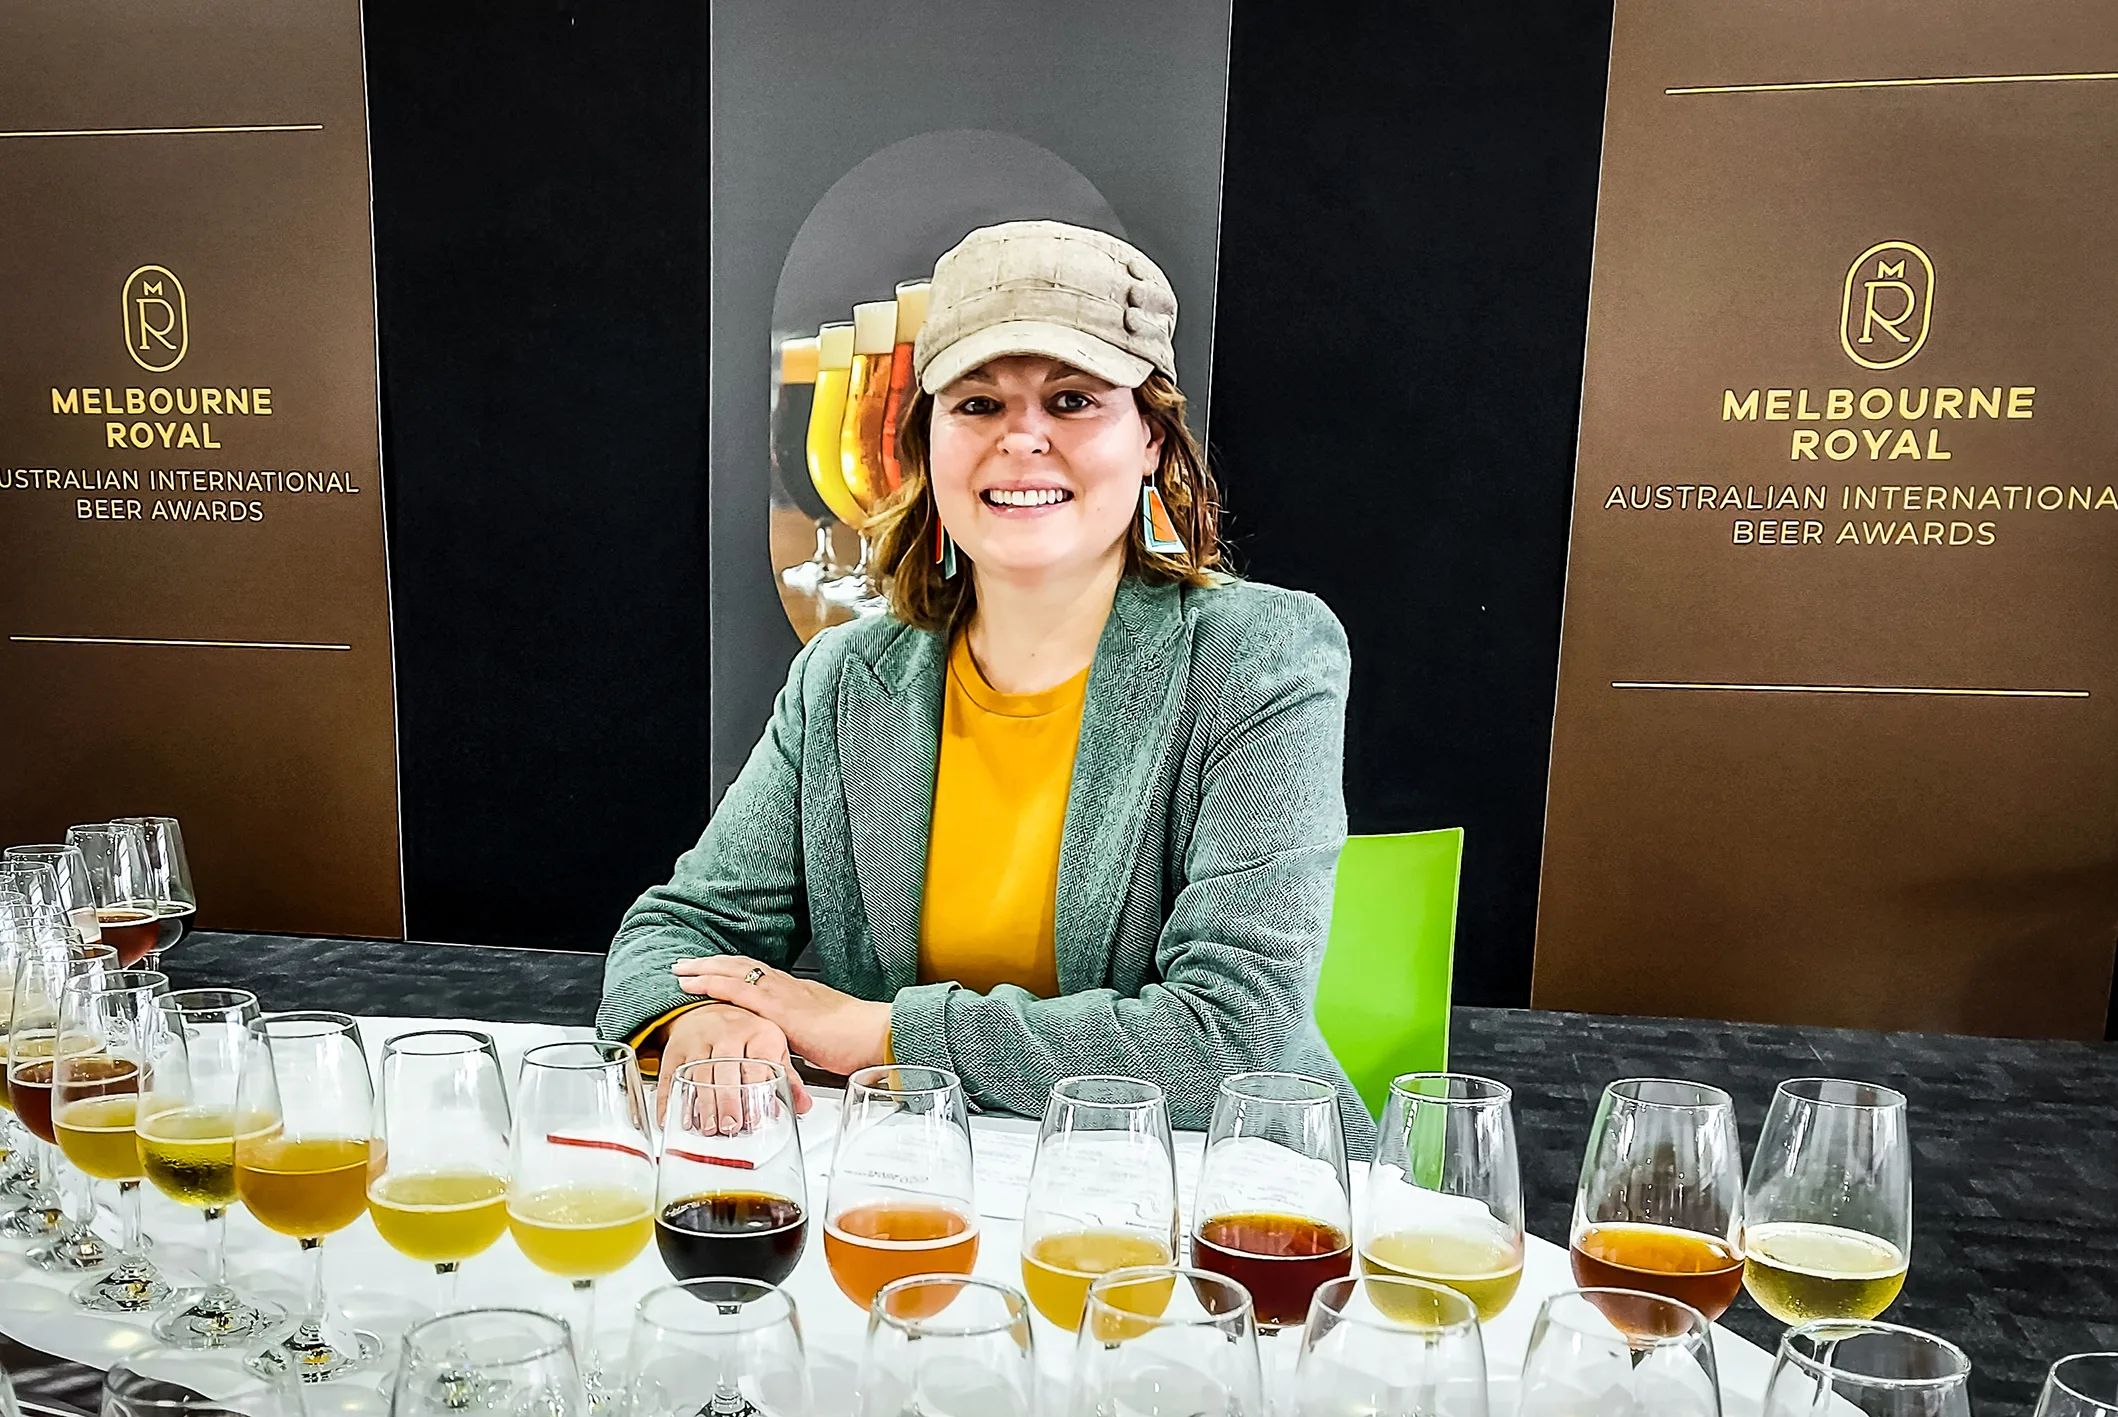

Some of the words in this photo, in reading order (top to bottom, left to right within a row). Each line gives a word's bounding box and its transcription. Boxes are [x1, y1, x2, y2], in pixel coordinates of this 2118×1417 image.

[51, 387, 273, 415] MELBOURNE
[1722, 386, 2037, 421] MELBOURNE
[106, 421, 222, 449] ROYAL
[1789, 428, 1953, 460] ROYAL
[150, 470, 360, 494] INTERNATIONAL
[77, 499, 142, 520] BEER
[151, 500, 264, 522] AWARDS
[1604, 485, 1827, 510] AUSTRALIAN
[1732, 520, 1825, 545] BEER
[1835, 520, 1998, 546] AWARDS
